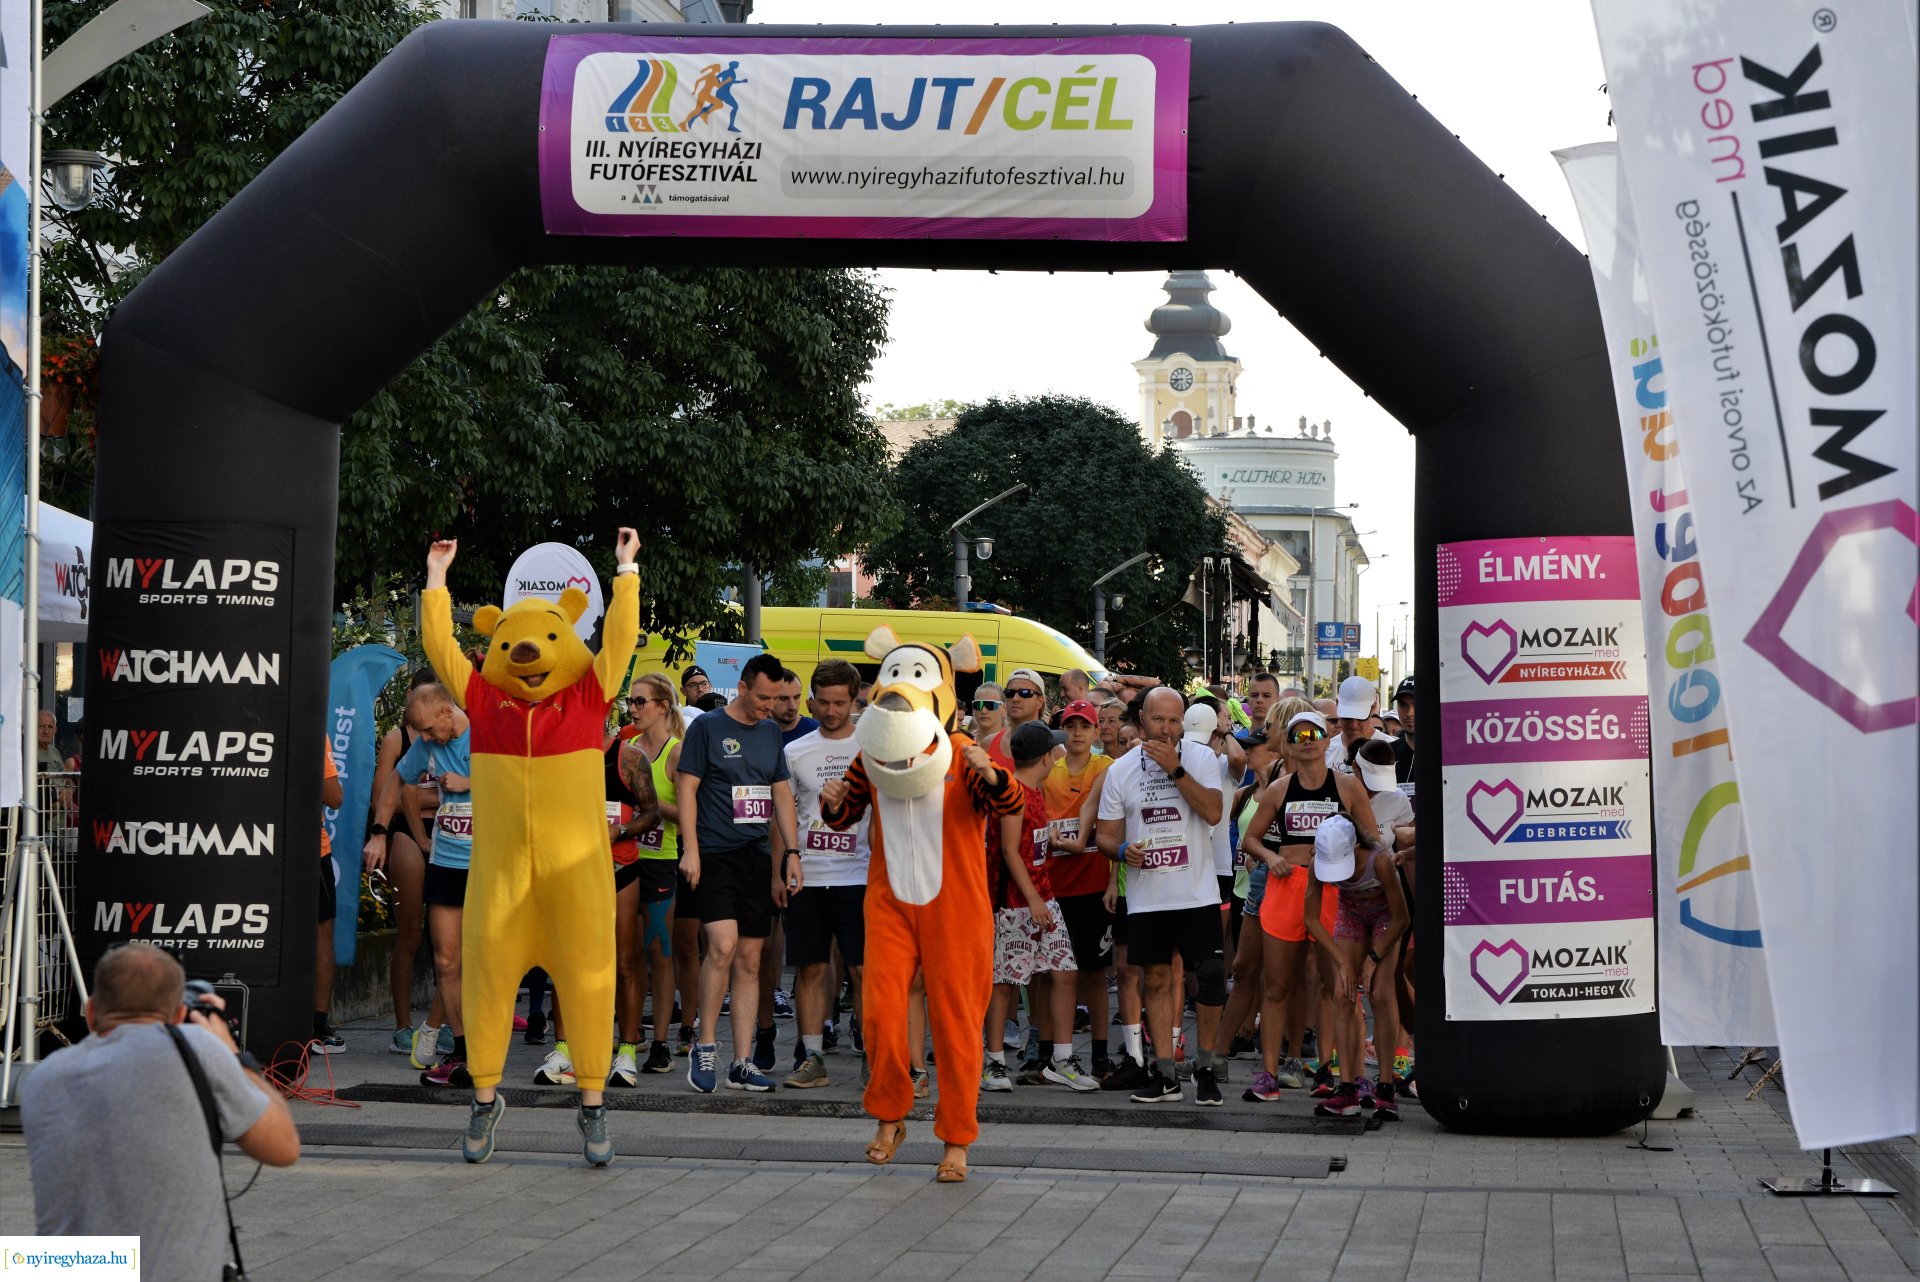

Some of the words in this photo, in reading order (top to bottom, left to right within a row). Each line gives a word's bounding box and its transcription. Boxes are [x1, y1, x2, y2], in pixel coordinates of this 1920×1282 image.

[783, 64, 1134, 135] RAJT/CÉL
[585, 140, 611, 158] III.
[618, 137, 763, 160] NYÍREGYHÁZI
[589, 159, 759, 183] FUTÓFESZTIVÁL
[790, 166, 1125, 191] www.nyiregyhazifutofesztival.hu
[668, 194, 730, 204] támogatásával
[1229, 469, 1292, 484] LUTHER
[1478, 548, 1606, 583] ÉLMÉNY.
[106, 557, 280, 592] MYLAPS
[139, 594, 208, 605] SPORTS
[215, 594, 275, 606] TIMING
[1594, 647, 1620, 658] med
[100, 649, 280, 686] WATCHMAN
[1519, 664, 1607, 678] NYÍREGYHÁZA
[1466, 708, 1626, 744] KÖZÖSSÉG.
[100, 729, 275, 763] MYLAPS
[133, 766, 203, 776] SPORTS
[211, 767, 270, 778] TIMING
[1600, 805, 1625, 817] med
[443, 818, 473, 833] 507
[1526, 826, 1607, 838] DEBRECEN
[93, 819, 275, 856] WATCHMAN
[812, 833, 850, 850] 5195
[1144, 849, 1181, 867] 5057
[1500, 870, 1605, 904] FUTÁS.
[94, 901, 270, 934] MYLAPS
[206, 939, 264, 949] TIMING
[1005, 940, 1033, 953] CHICAGO
[1605, 965, 1629, 977] med
[1531, 984, 1616, 999] TOKAJI-HEGY
